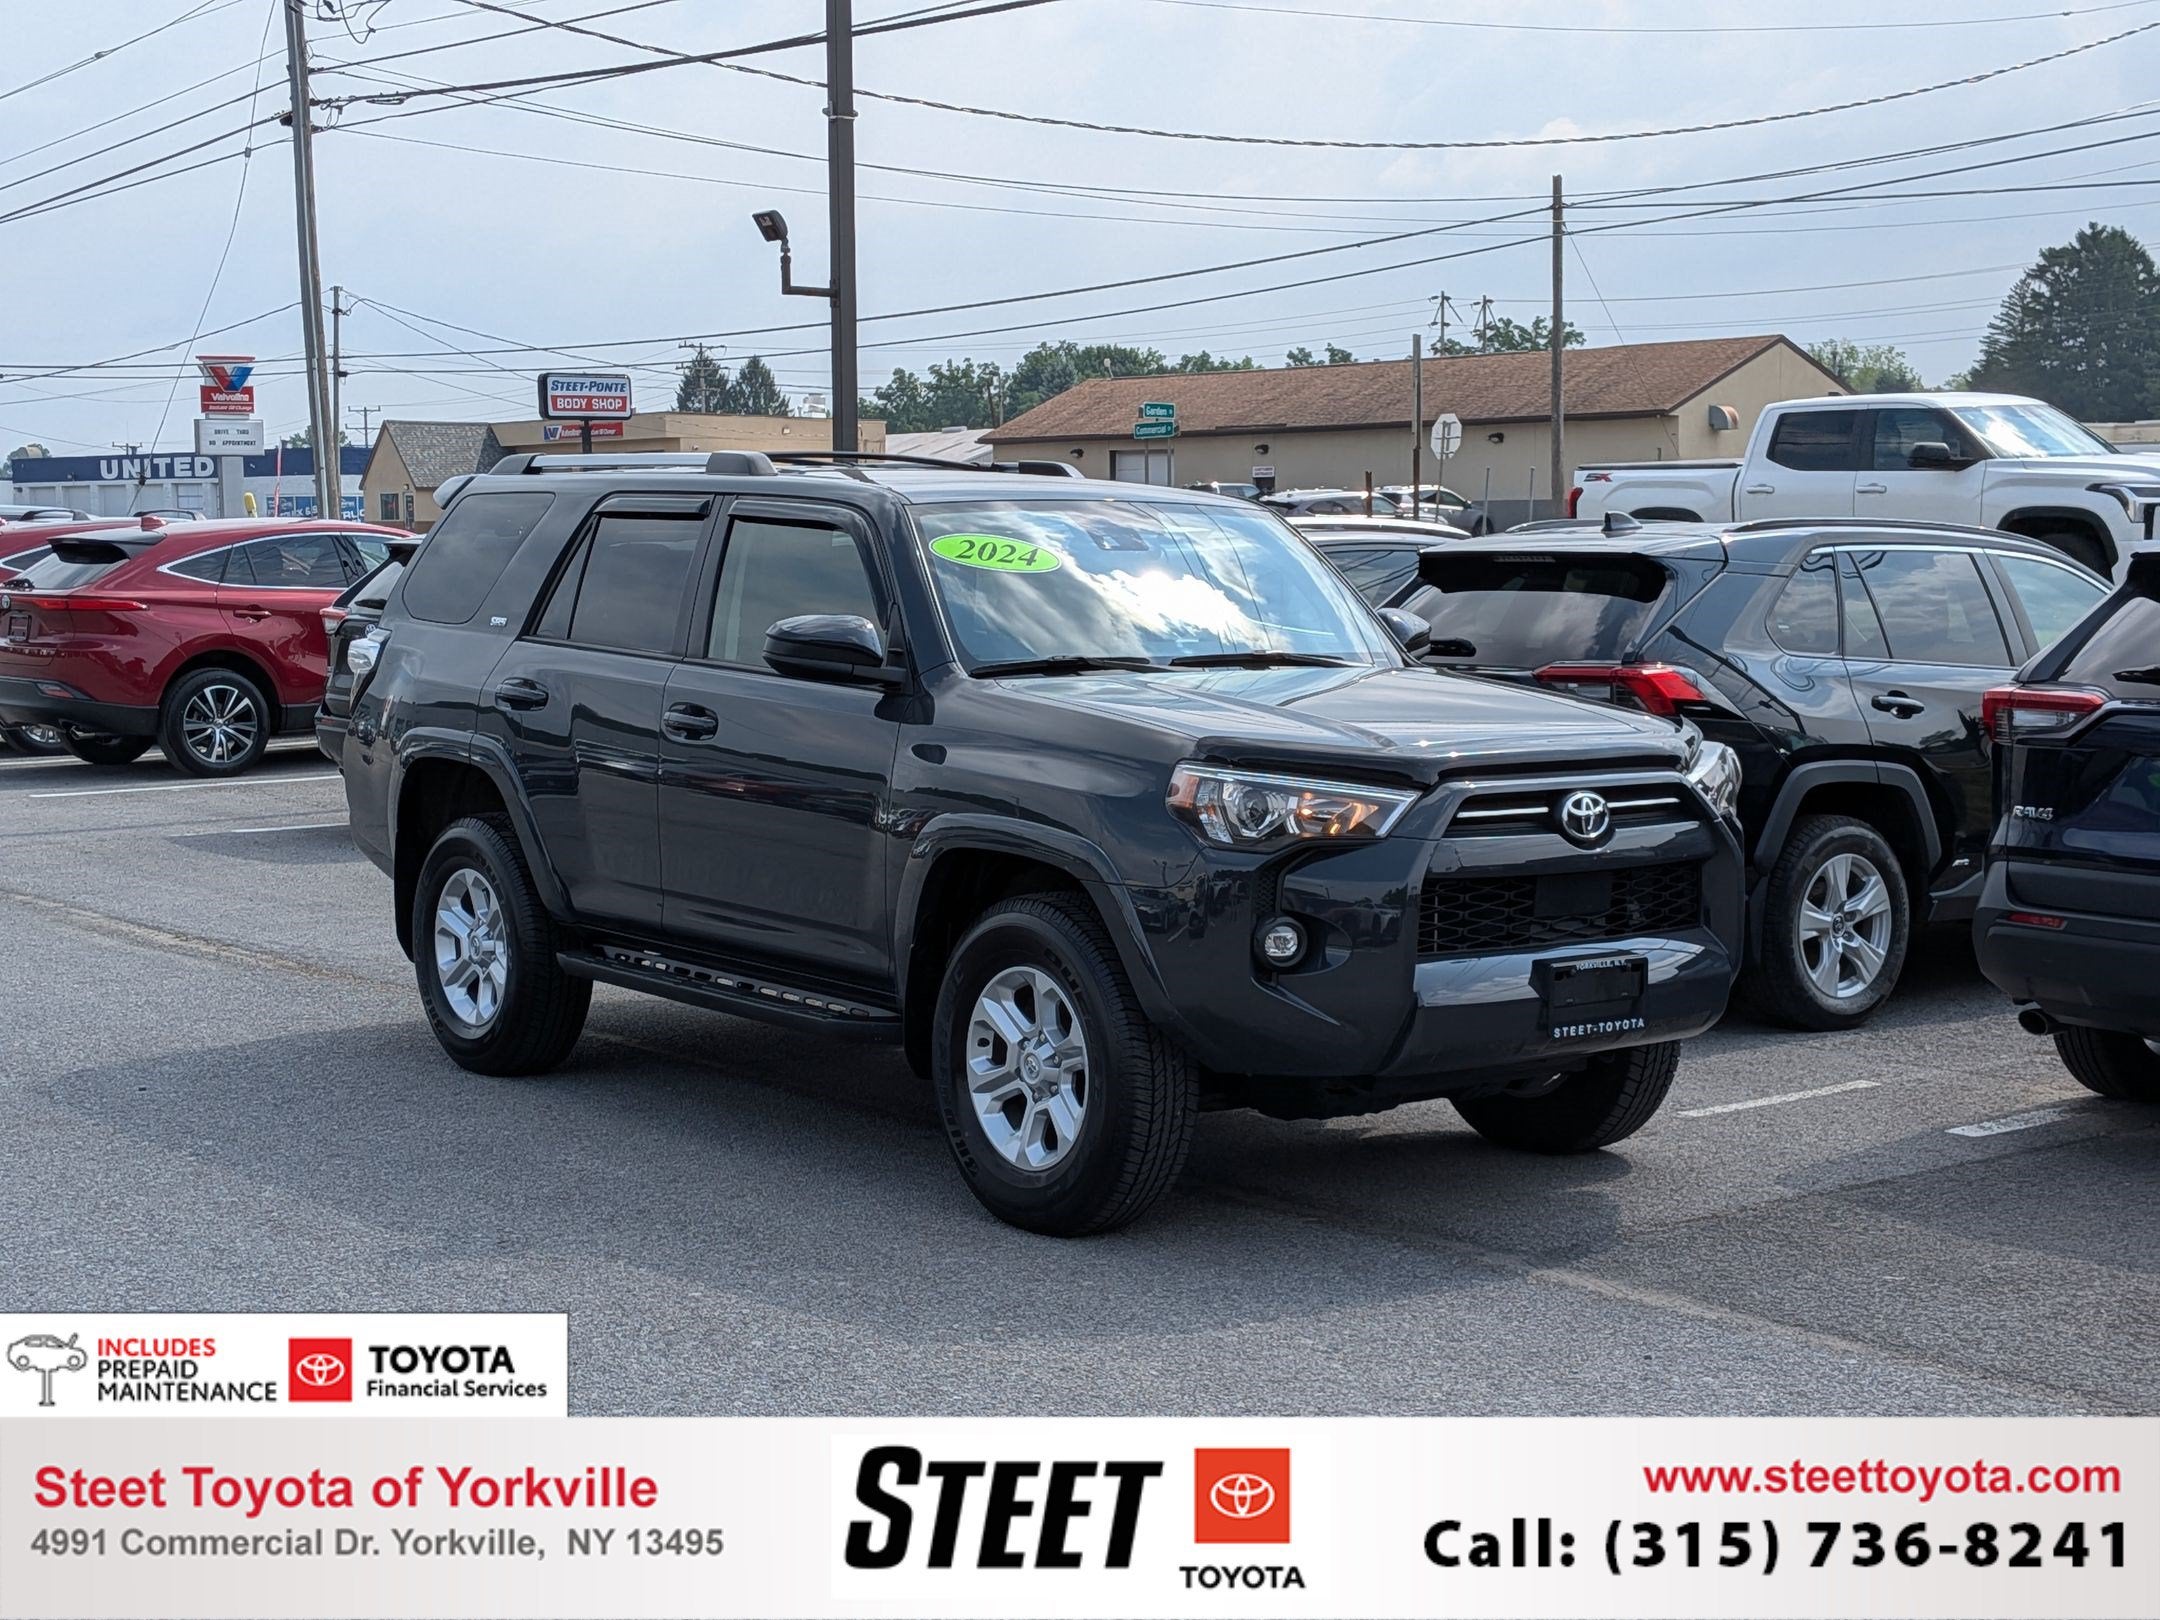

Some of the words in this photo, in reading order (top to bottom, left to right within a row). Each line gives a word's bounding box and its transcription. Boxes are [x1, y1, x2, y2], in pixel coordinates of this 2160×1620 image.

[550, 379, 627, 393] STEET-PONTE
[210, 392, 250, 402] Valvoline
[556, 397, 587, 409] BODY
[591, 398, 623, 410] SHOP
[100, 456, 215, 480] UNITED
[955, 539, 1040, 566] 2024
[1553, 1017, 1645, 1039] STEET-TOYOTA
